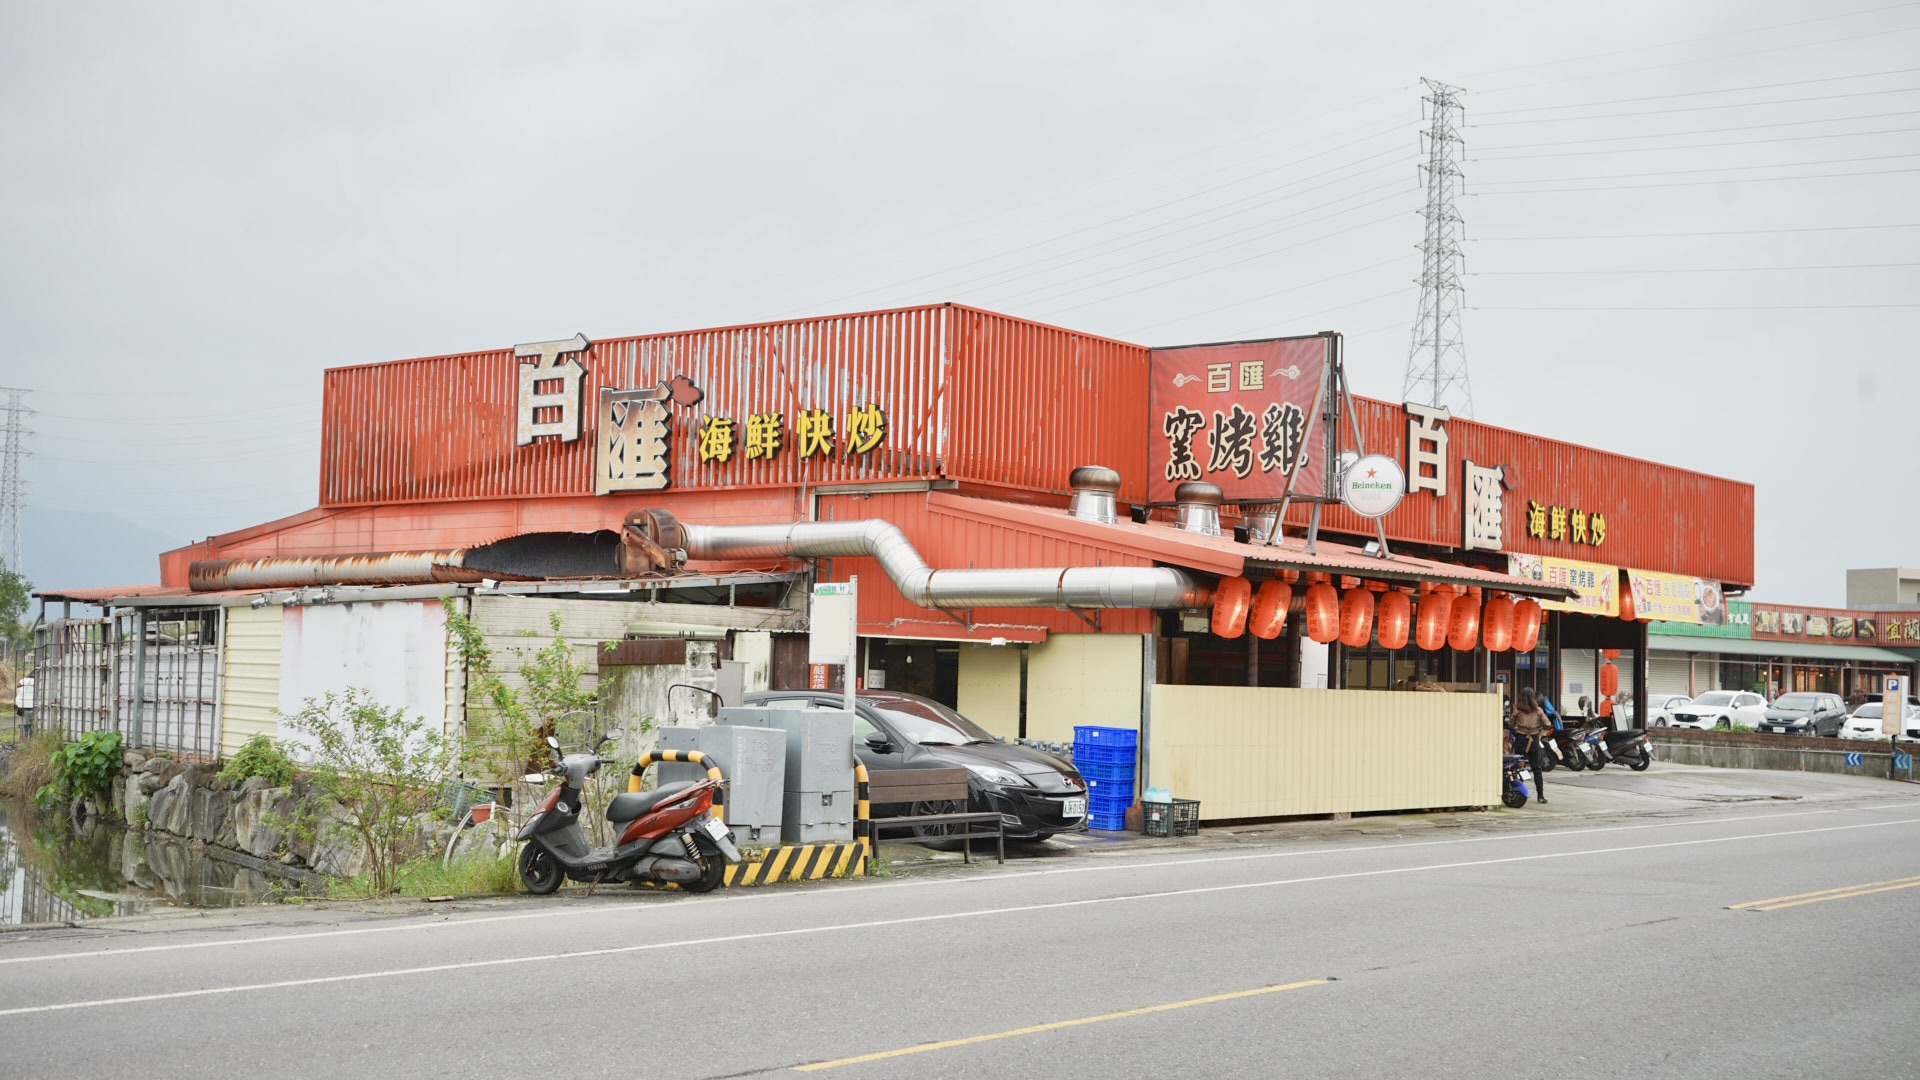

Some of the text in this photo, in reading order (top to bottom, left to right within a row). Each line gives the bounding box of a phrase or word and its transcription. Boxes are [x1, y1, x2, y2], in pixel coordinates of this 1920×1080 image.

[1207, 360, 1265, 393] 百匯
[700, 403, 888, 464] 海鮮快炒
[1164, 402, 1309, 481] 窯烤雞
[1352, 481, 1392, 490] Heineken
[1527, 500, 1606, 546] 海鮮快炒
[1888, 679, 1898, 690] P
[588, 863, 608, 871] YAMAHA
